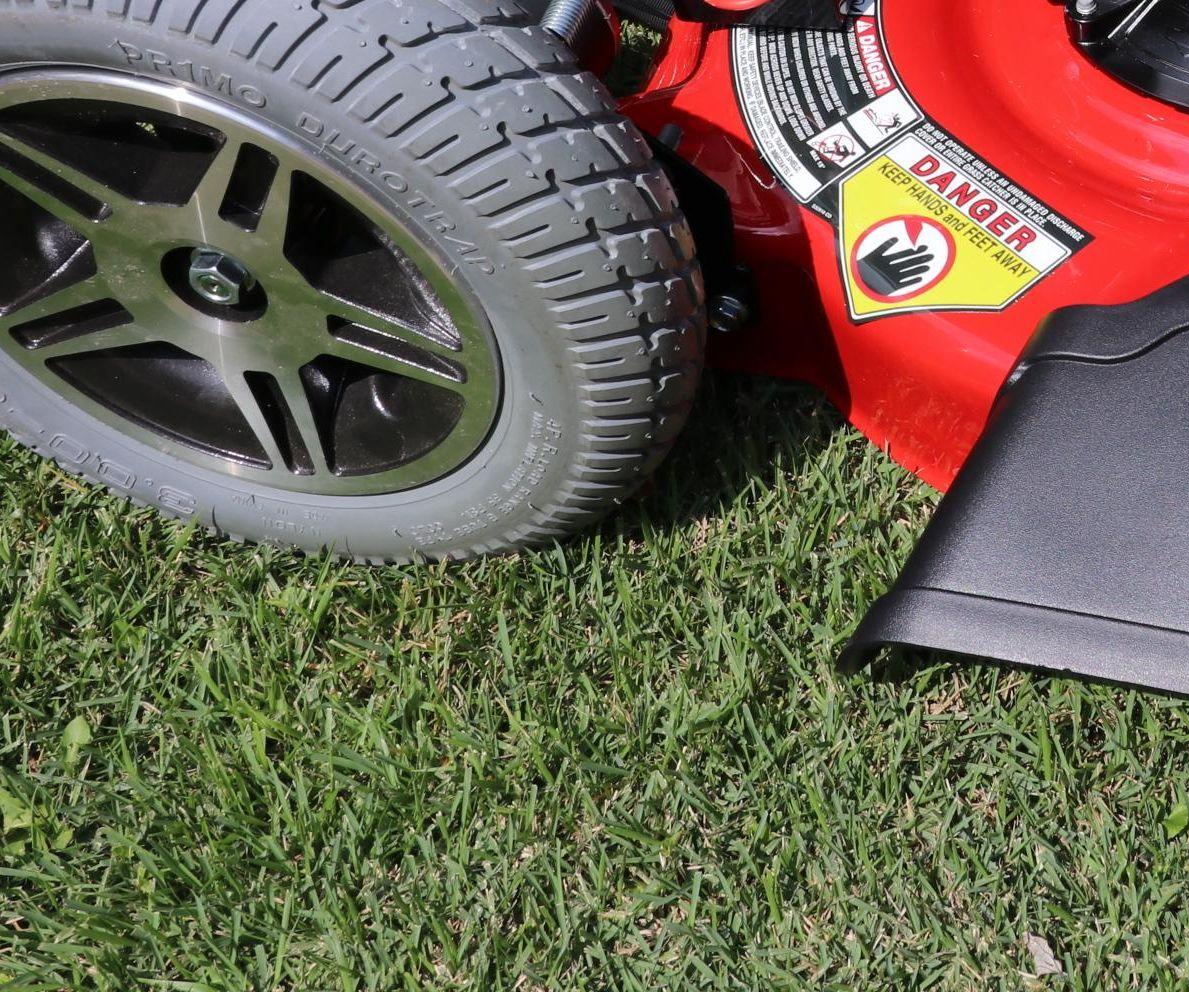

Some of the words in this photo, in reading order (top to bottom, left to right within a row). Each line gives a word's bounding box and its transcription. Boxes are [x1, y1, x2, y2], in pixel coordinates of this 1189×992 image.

[858, 32, 891, 91] DANGER
[294, 110, 496, 276] DUROTRAP
[878, 162, 912, 186] KEEP
[906, 183, 949, 217] HANDS
[942, 213, 965, 233] and
[963, 229, 998, 253] FEET
[990, 249, 1032, 279] AWAY
[909, 154, 1037, 252] DANGER
[915, 128, 938, 146] COVER
[934, 142, 946, 153] OR
[942, 148, 966, 167] ENTIRE
[962, 162, 984, 181] GRASS
[981, 176, 1011, 201] CATCHER
[1008, 195, 1019, 205] IS
[1016, 202, 1027, 212] IN
[1023, 208, 1048, 228] PLACE.
[922, 122, 934, 133] DO
[931, 129, 949, 142] NOT
[945, 137, 975, 163] OPERATE
[972, 156, 999, 179] UNLESS
[996, 174, 1010, 188] AN
[1007, 181, 1049, 216] UNDAMAGED
[1047, 213, 1085, 243] DISCHARGE
